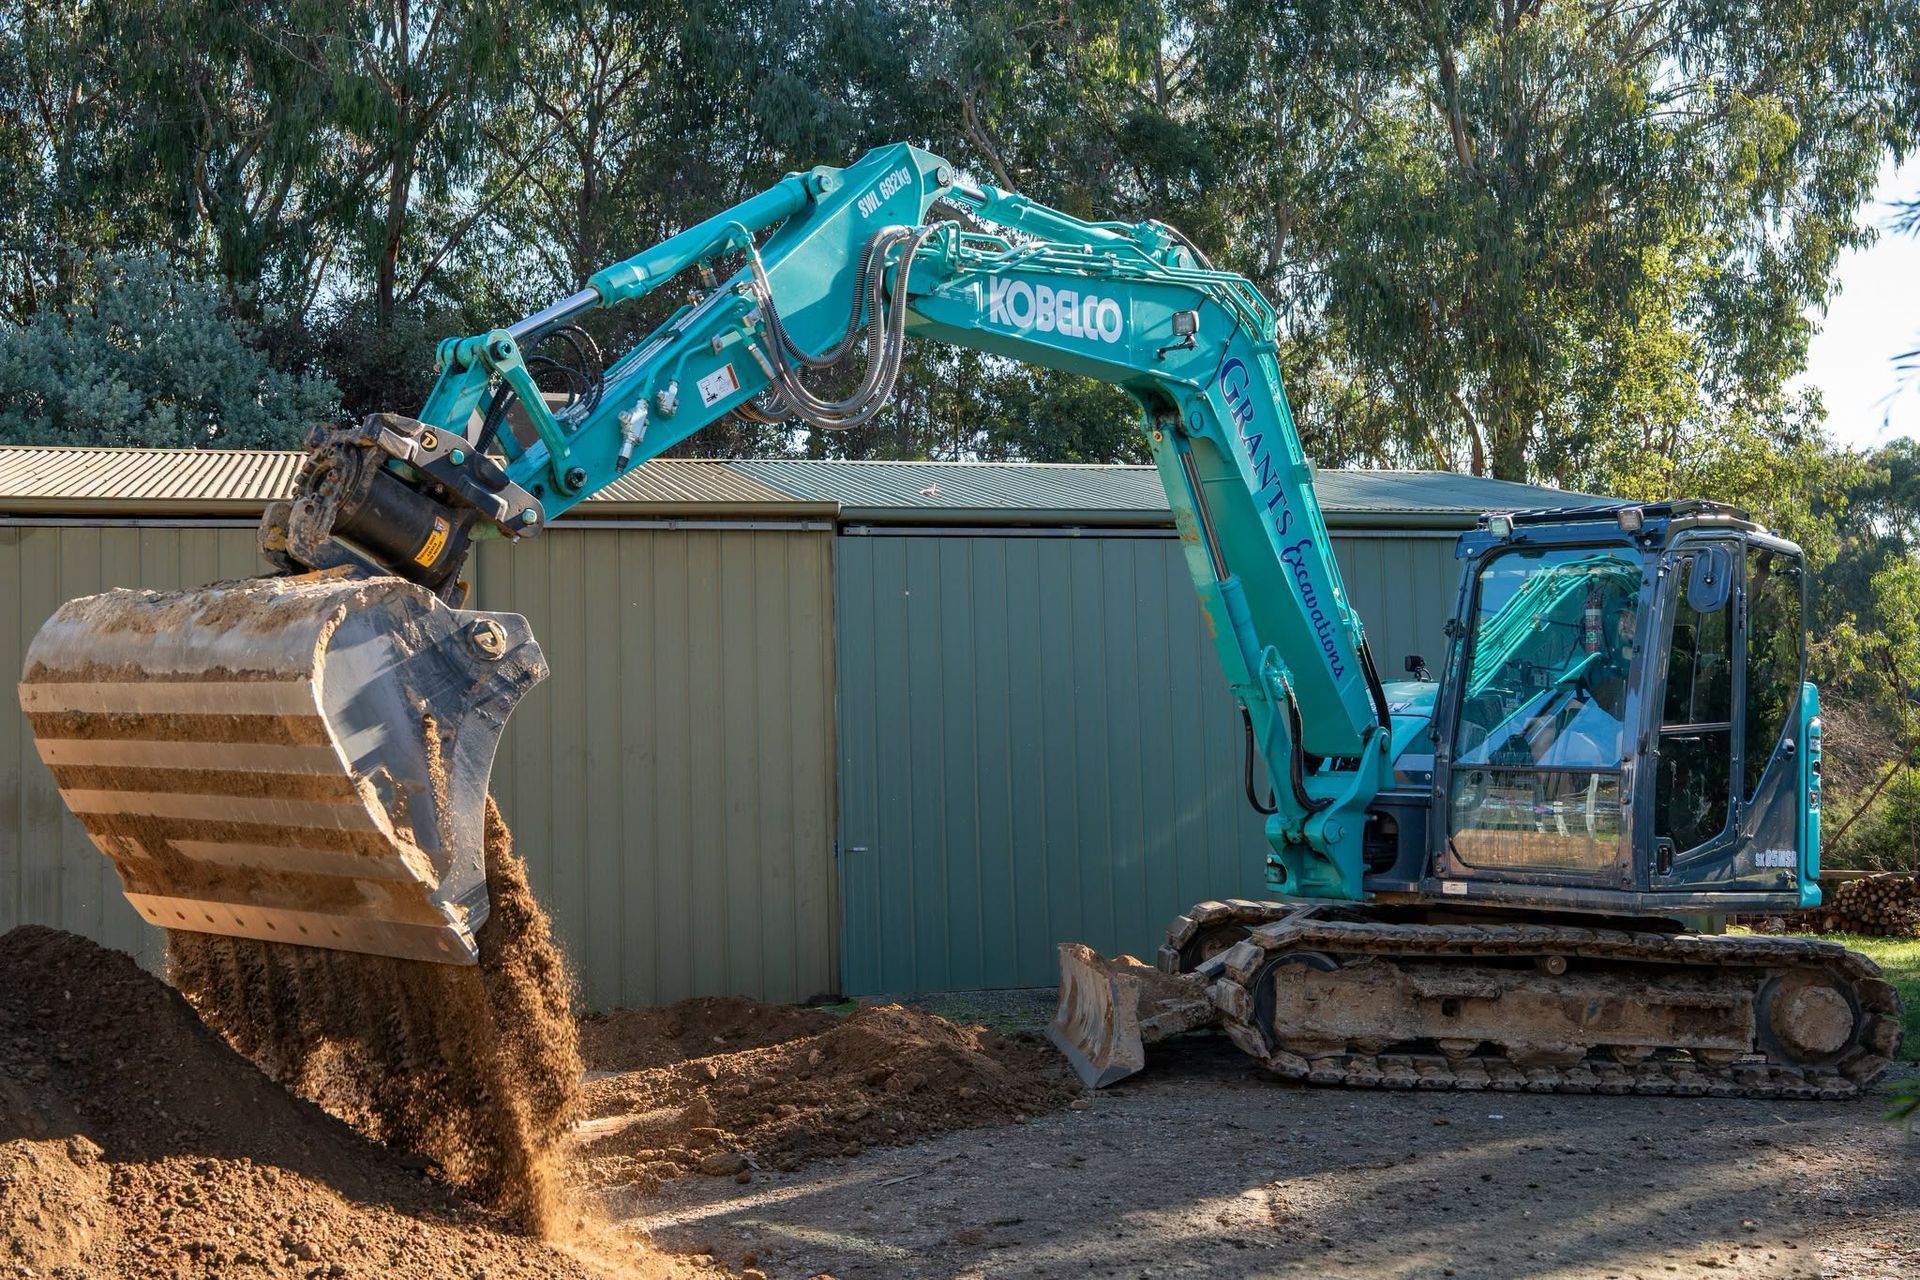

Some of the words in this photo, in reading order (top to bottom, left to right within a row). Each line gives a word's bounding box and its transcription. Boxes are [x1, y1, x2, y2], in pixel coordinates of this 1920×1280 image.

[857, 190, 883, 219] SWL
[989, 275, 1124, 344] KOBELCO
[1219, 356, 1295, 537] GRANTS
[1280, 538, 1345, 681] Excavations
